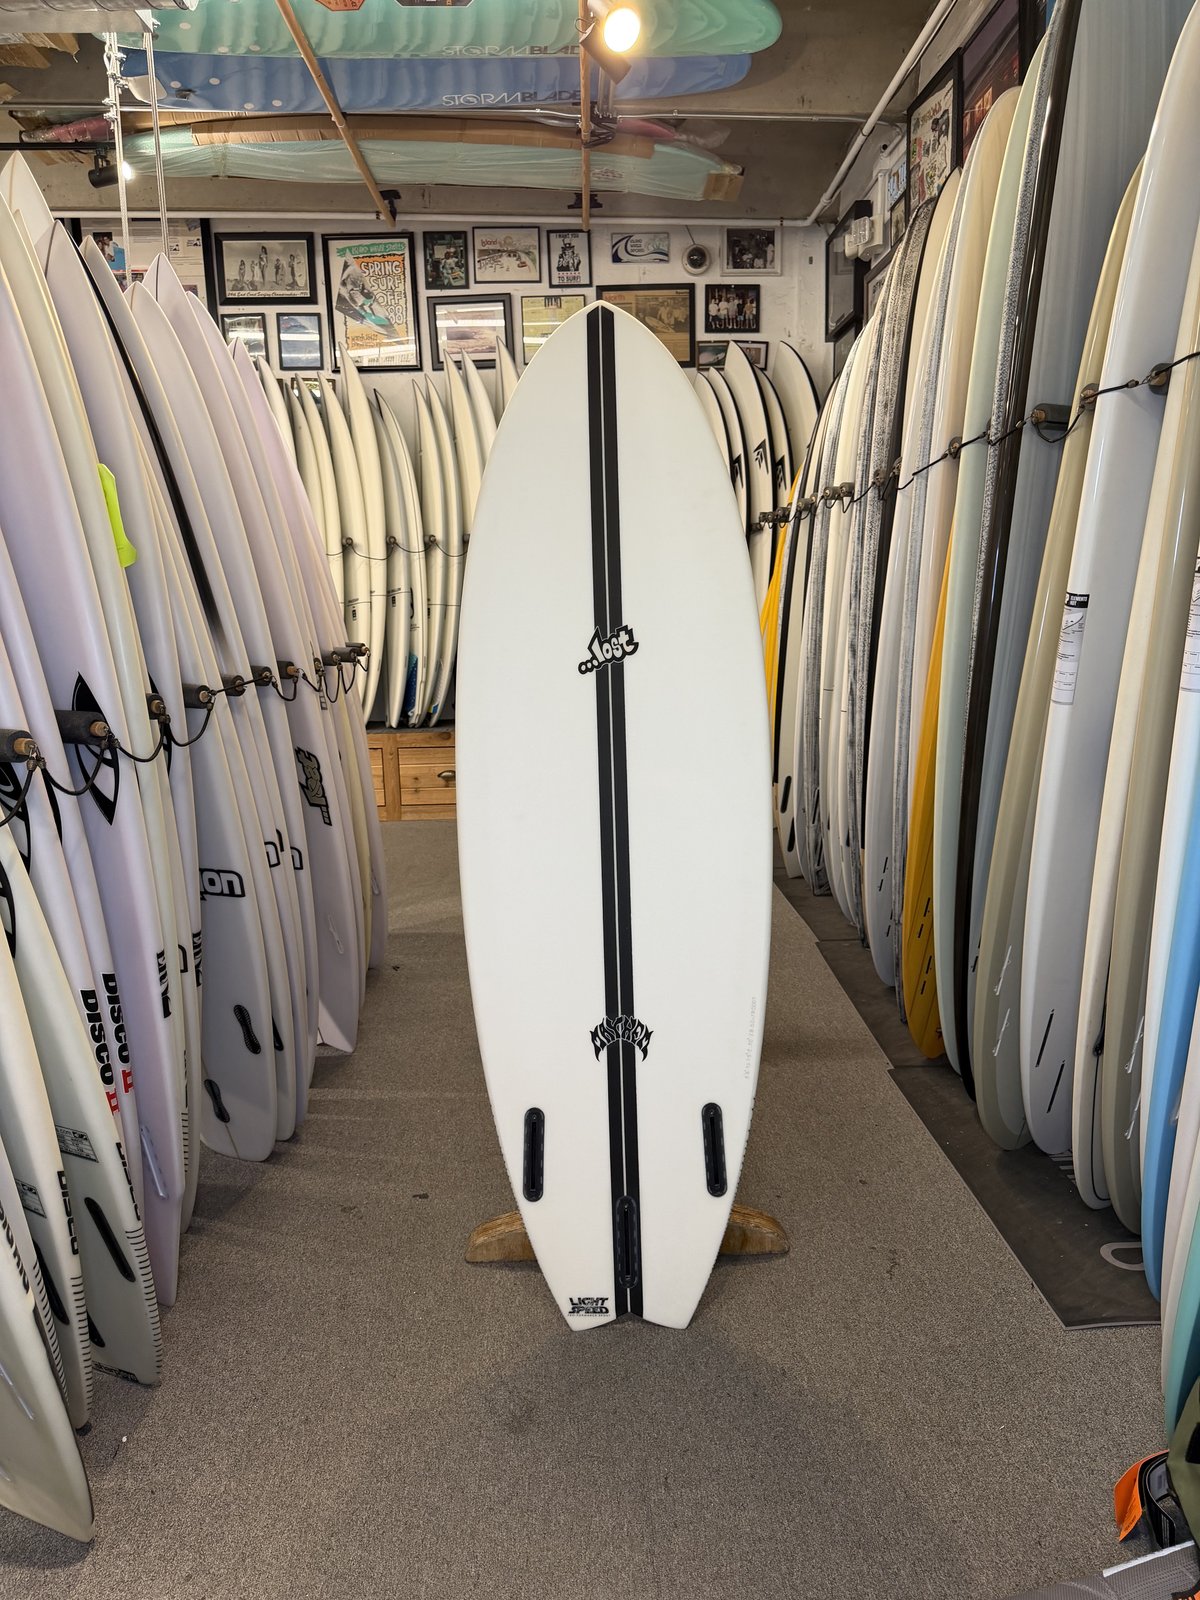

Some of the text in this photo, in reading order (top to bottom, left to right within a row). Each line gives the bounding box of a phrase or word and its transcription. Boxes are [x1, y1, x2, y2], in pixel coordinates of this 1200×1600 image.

[442, 45, 580, 56] STORMBLAD
[361, 261, 402, 277] SPRING
[370, 275, 404, 291] SURF
[375, 291, 402, 306] OFF
[101, 973, 131, 1064] DISCO
[80, 989, 114, 1086] DISCO
[568, 1297, 609, 1306] LIGHT
[568, 1306, 610, 1314] SPEED
